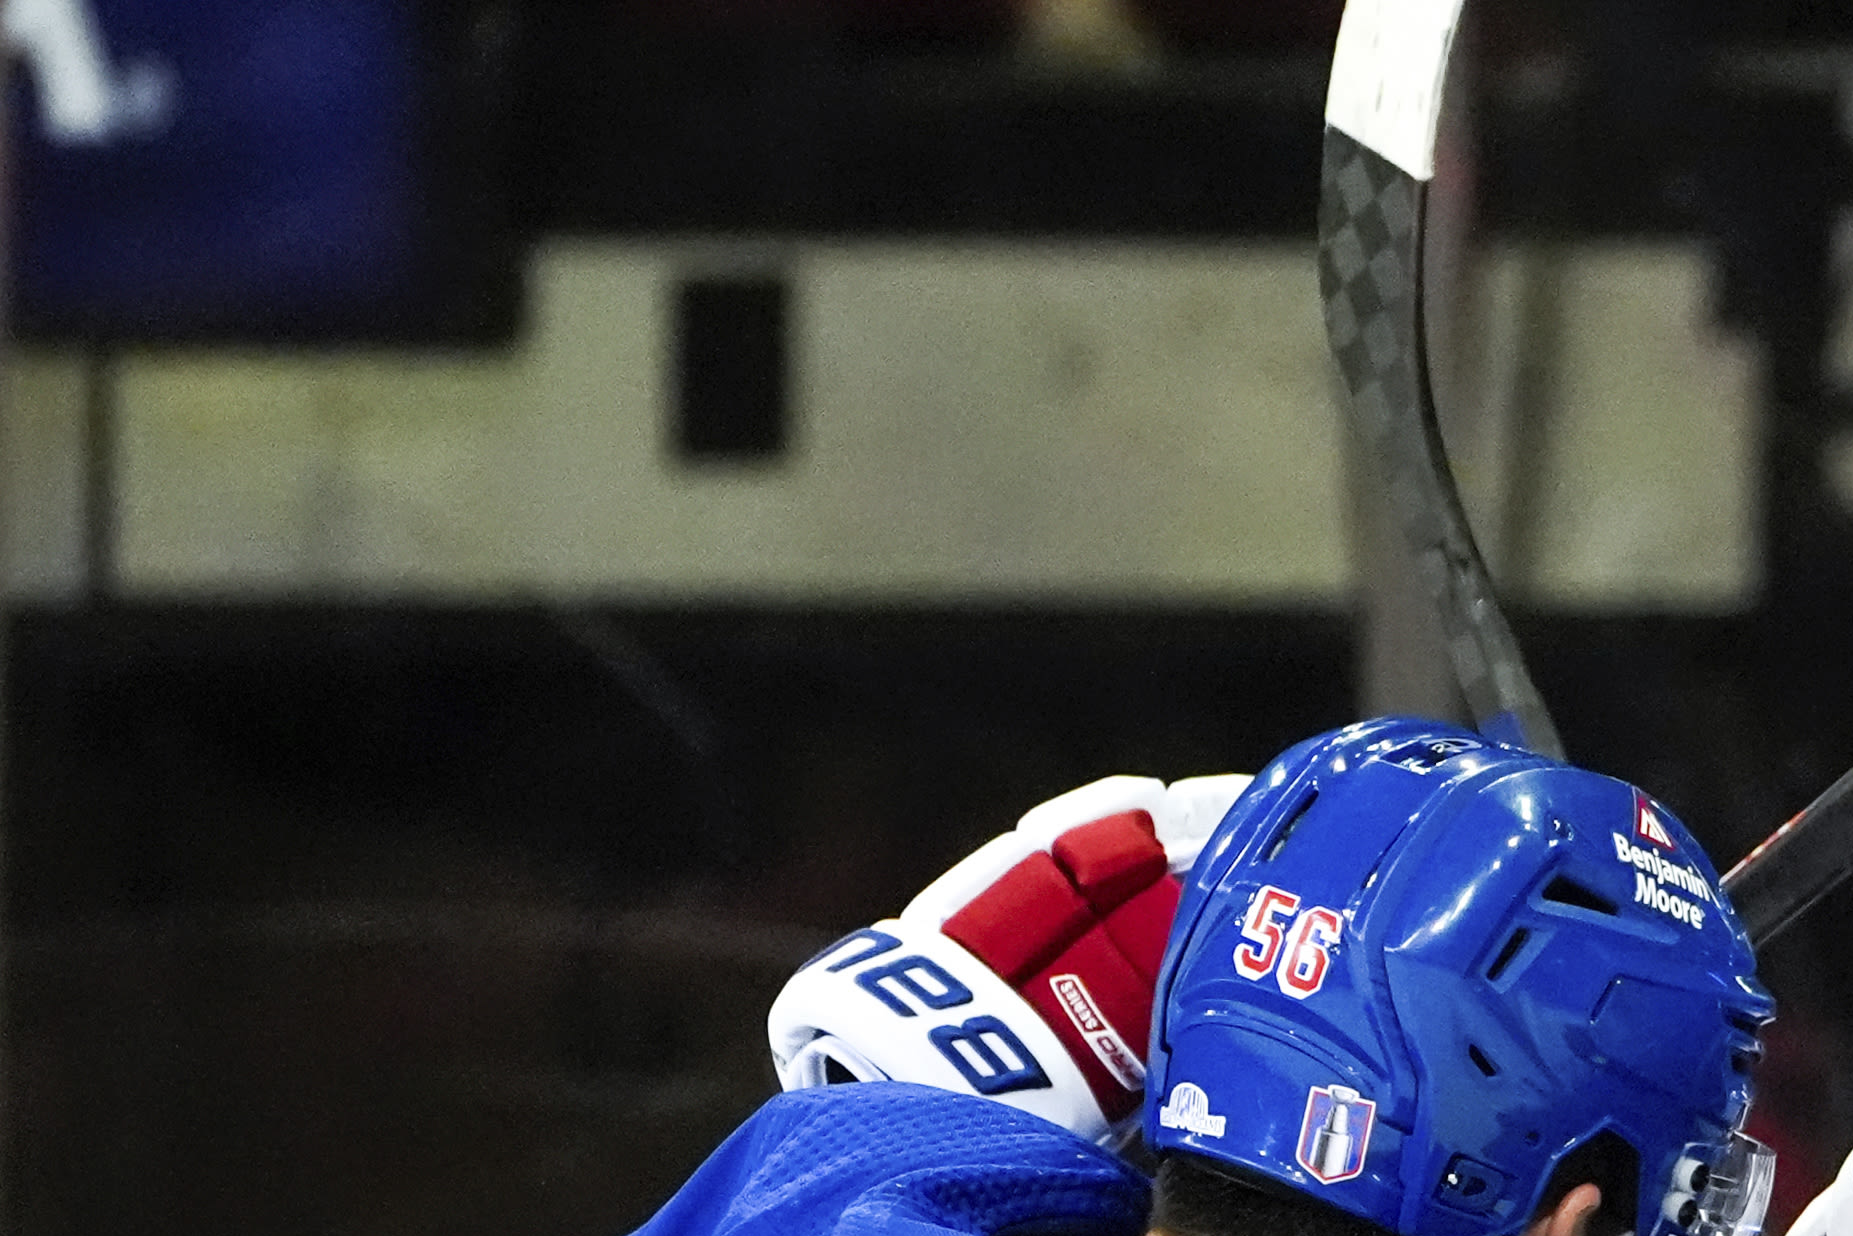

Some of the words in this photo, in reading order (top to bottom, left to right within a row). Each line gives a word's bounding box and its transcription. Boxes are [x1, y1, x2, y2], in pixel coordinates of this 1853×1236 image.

[1612, 831, 1710, 902] Benjamin
[1634, 872, 1704, 930] Moore
[1232, 884, 1344, 1001] 56
[1059, 980, 1100, 1030] SERIES
